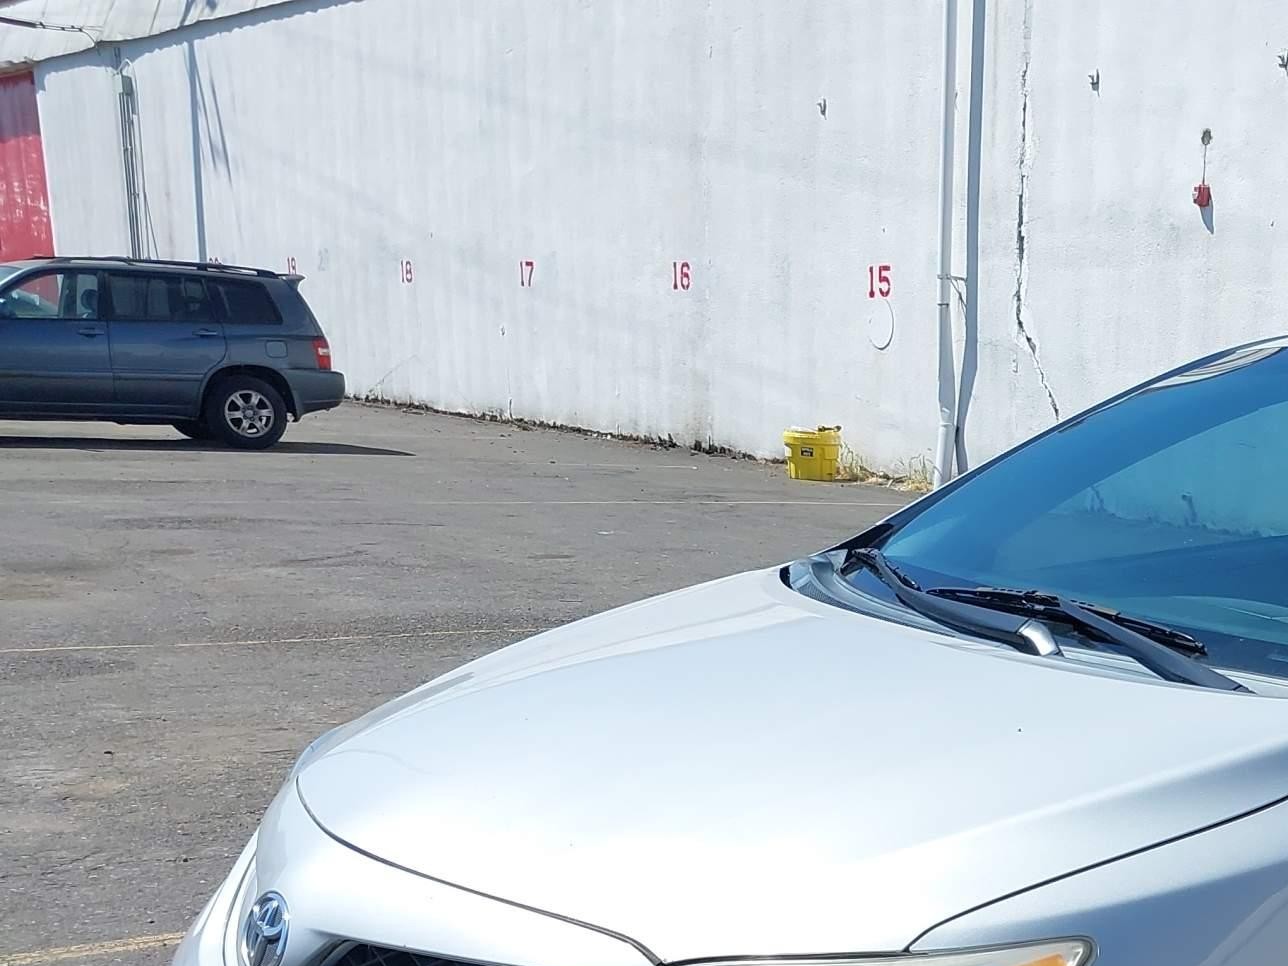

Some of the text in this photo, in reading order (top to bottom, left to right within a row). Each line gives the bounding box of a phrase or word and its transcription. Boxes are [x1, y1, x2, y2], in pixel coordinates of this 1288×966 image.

[400, 260, 413, 283] 18
[519, 260, 535, 288] 17
[673, 261, 691, 291] 16
[868, 264, 892, 299] 15
